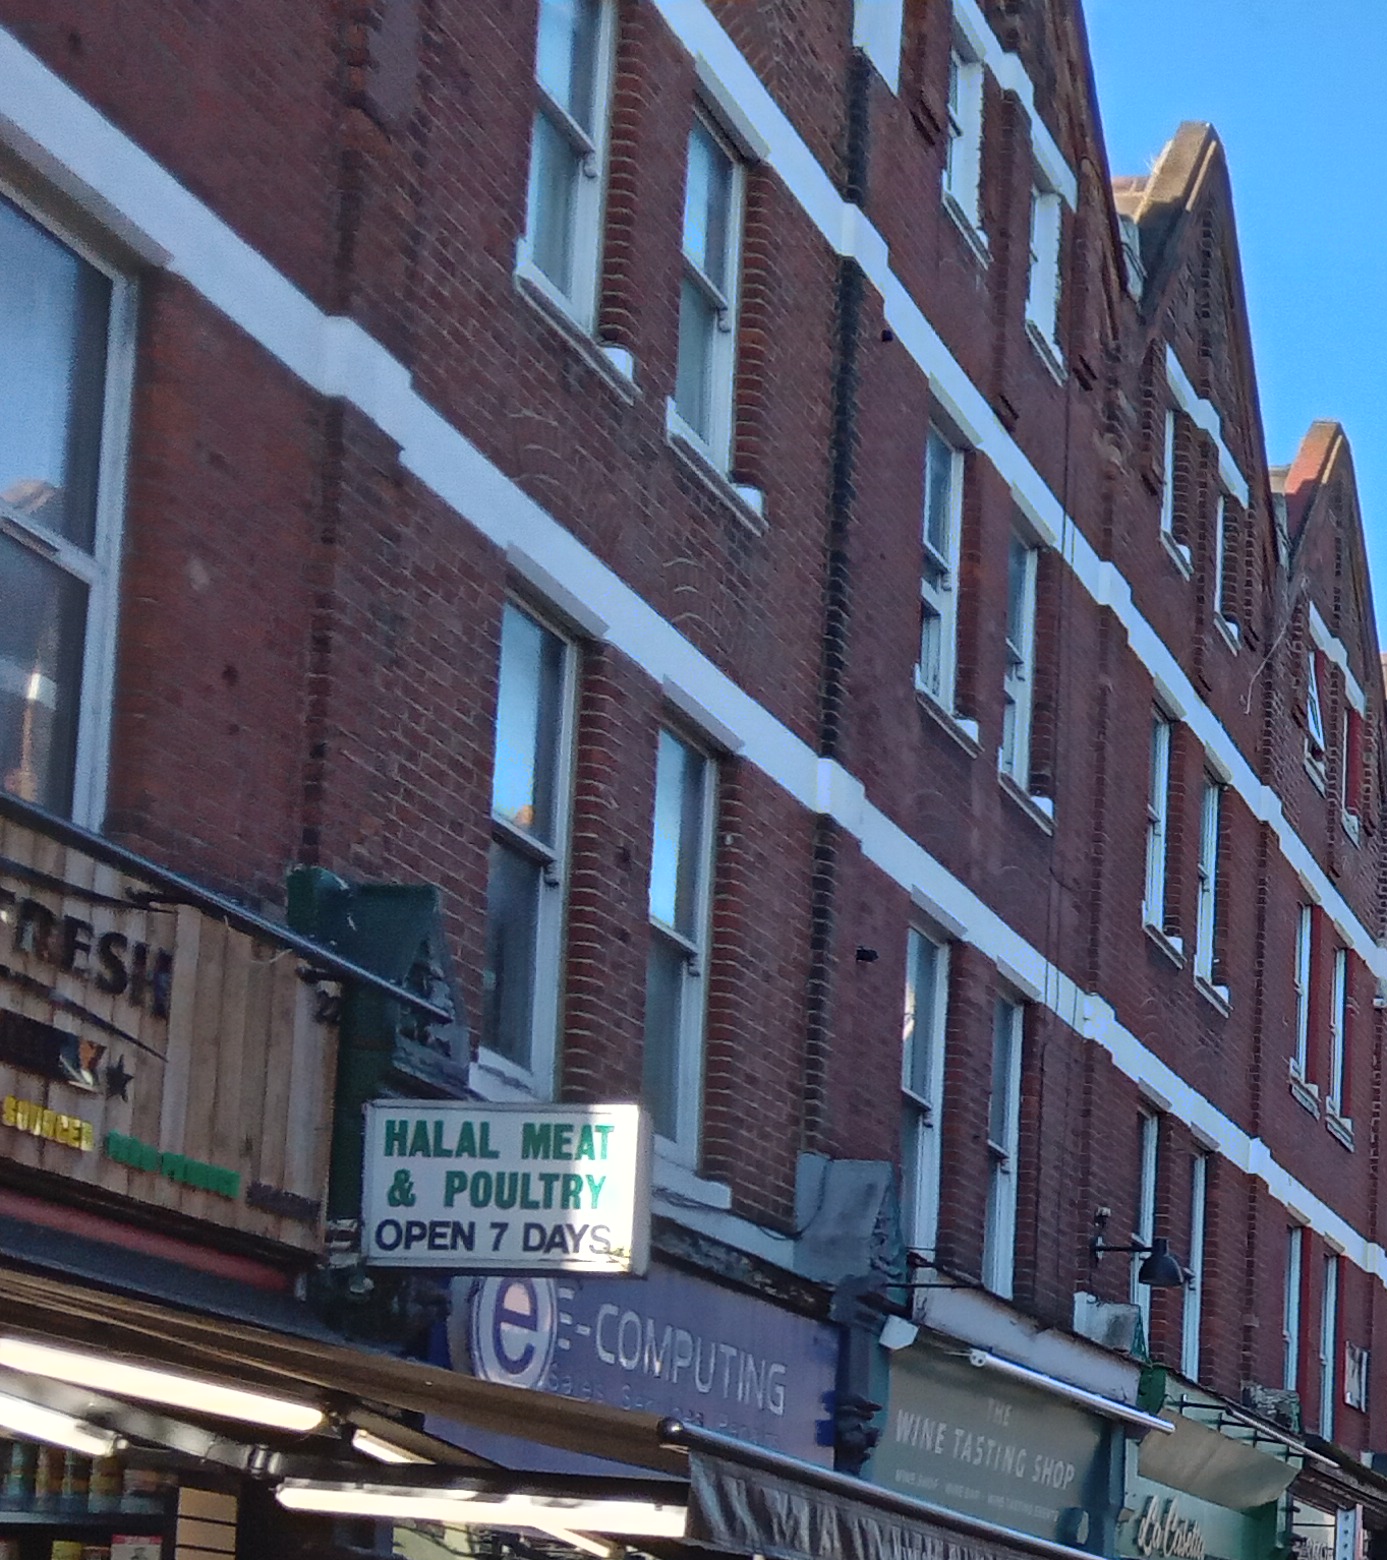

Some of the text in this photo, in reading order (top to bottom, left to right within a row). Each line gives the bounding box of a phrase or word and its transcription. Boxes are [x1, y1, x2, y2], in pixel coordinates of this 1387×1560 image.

[384, 1119, 615, 1161] HALAL MEAT
[387, 1168, 606, 1210] & POULTRY
[375, 1218, 612, 1255] OPEN 7 DAYS
[557, 1286, 787, 1416] E-COMPUTING
[988, 1399, 1012, 1427] THE
[896, 1409, 1076, 1490] WINE TASTING SHOP
